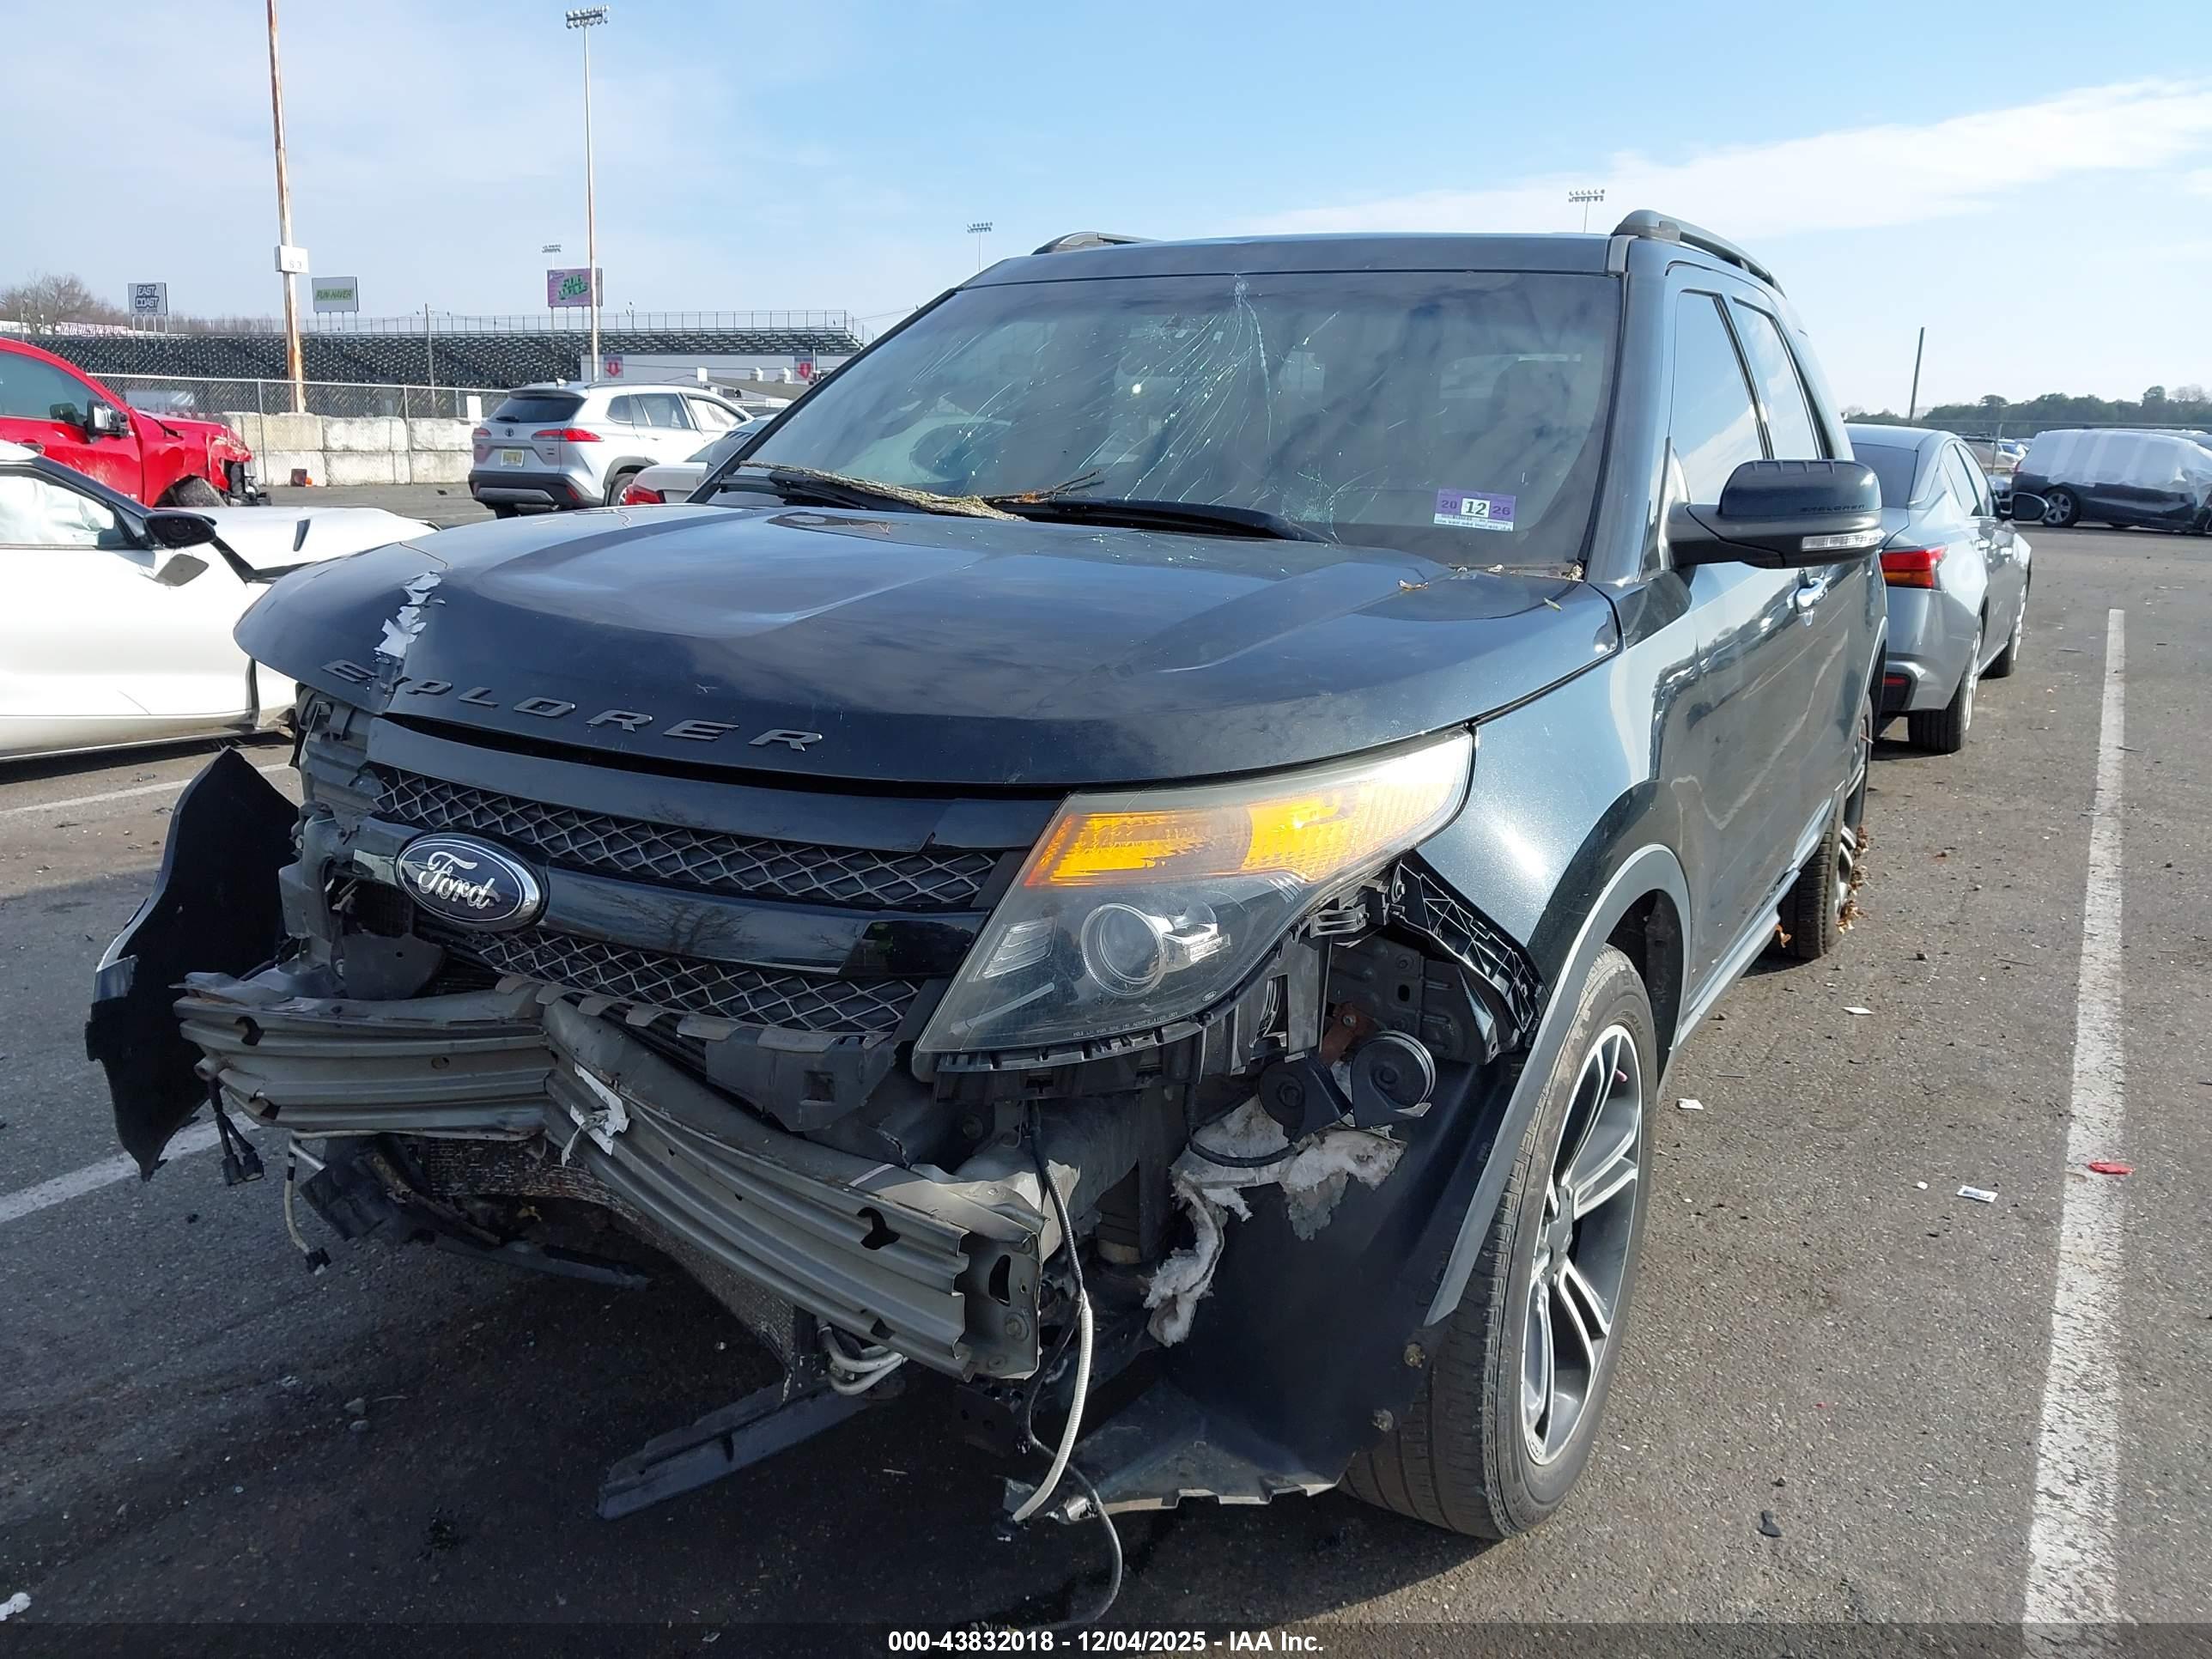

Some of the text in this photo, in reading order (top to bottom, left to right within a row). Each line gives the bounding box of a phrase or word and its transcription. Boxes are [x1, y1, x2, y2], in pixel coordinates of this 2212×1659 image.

[137, 284, 156, 296] EAST
[136, 296, 159, 308] COAST
[1442, 500, 1511, 515] 20 12 26
[417, 851, 495, 910] Ford
